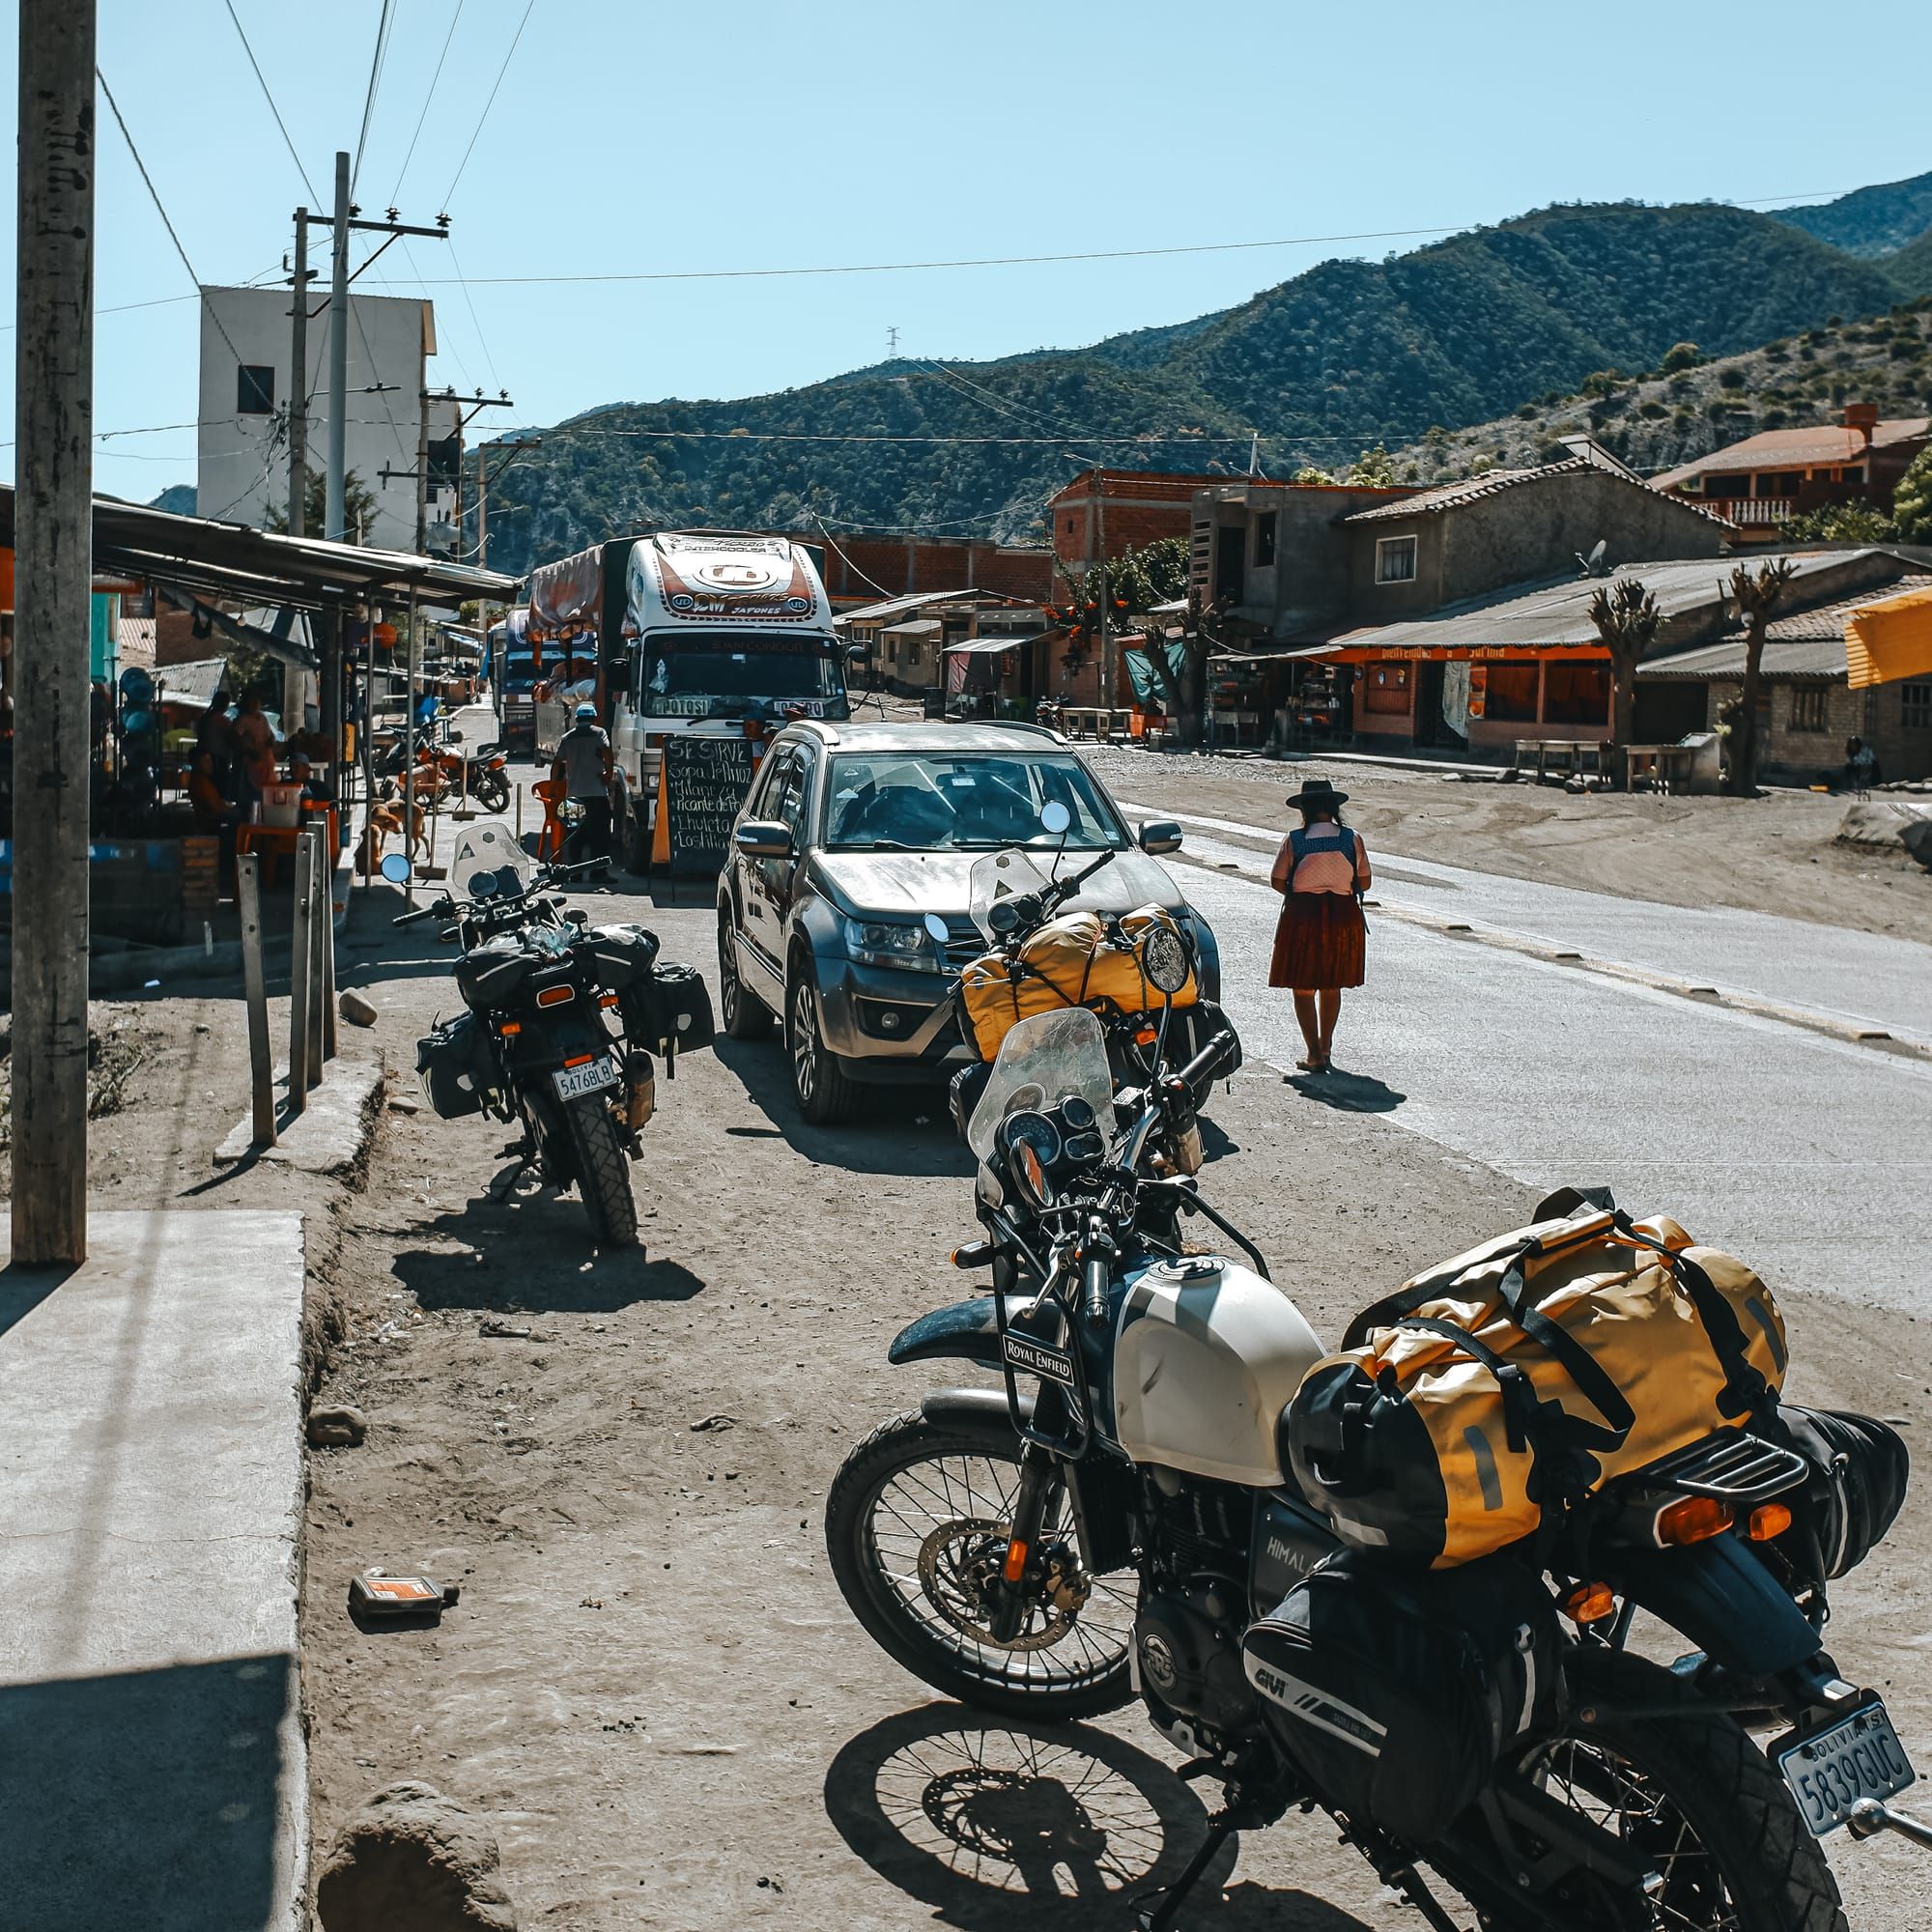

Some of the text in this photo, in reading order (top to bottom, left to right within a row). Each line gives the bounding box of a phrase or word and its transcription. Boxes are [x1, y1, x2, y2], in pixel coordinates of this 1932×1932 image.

[664, 699, 706, 714] POTOSI
[669, 740, 748, 762] SE SIRVE
[677, 793, 715, 811] Picante
[560, 1065, 611, 1095] 5476BLB
[1811, 1727, 1864, 1763] BOLIVIA
[1799, 1734, 1903, 1821] 5839GUC
